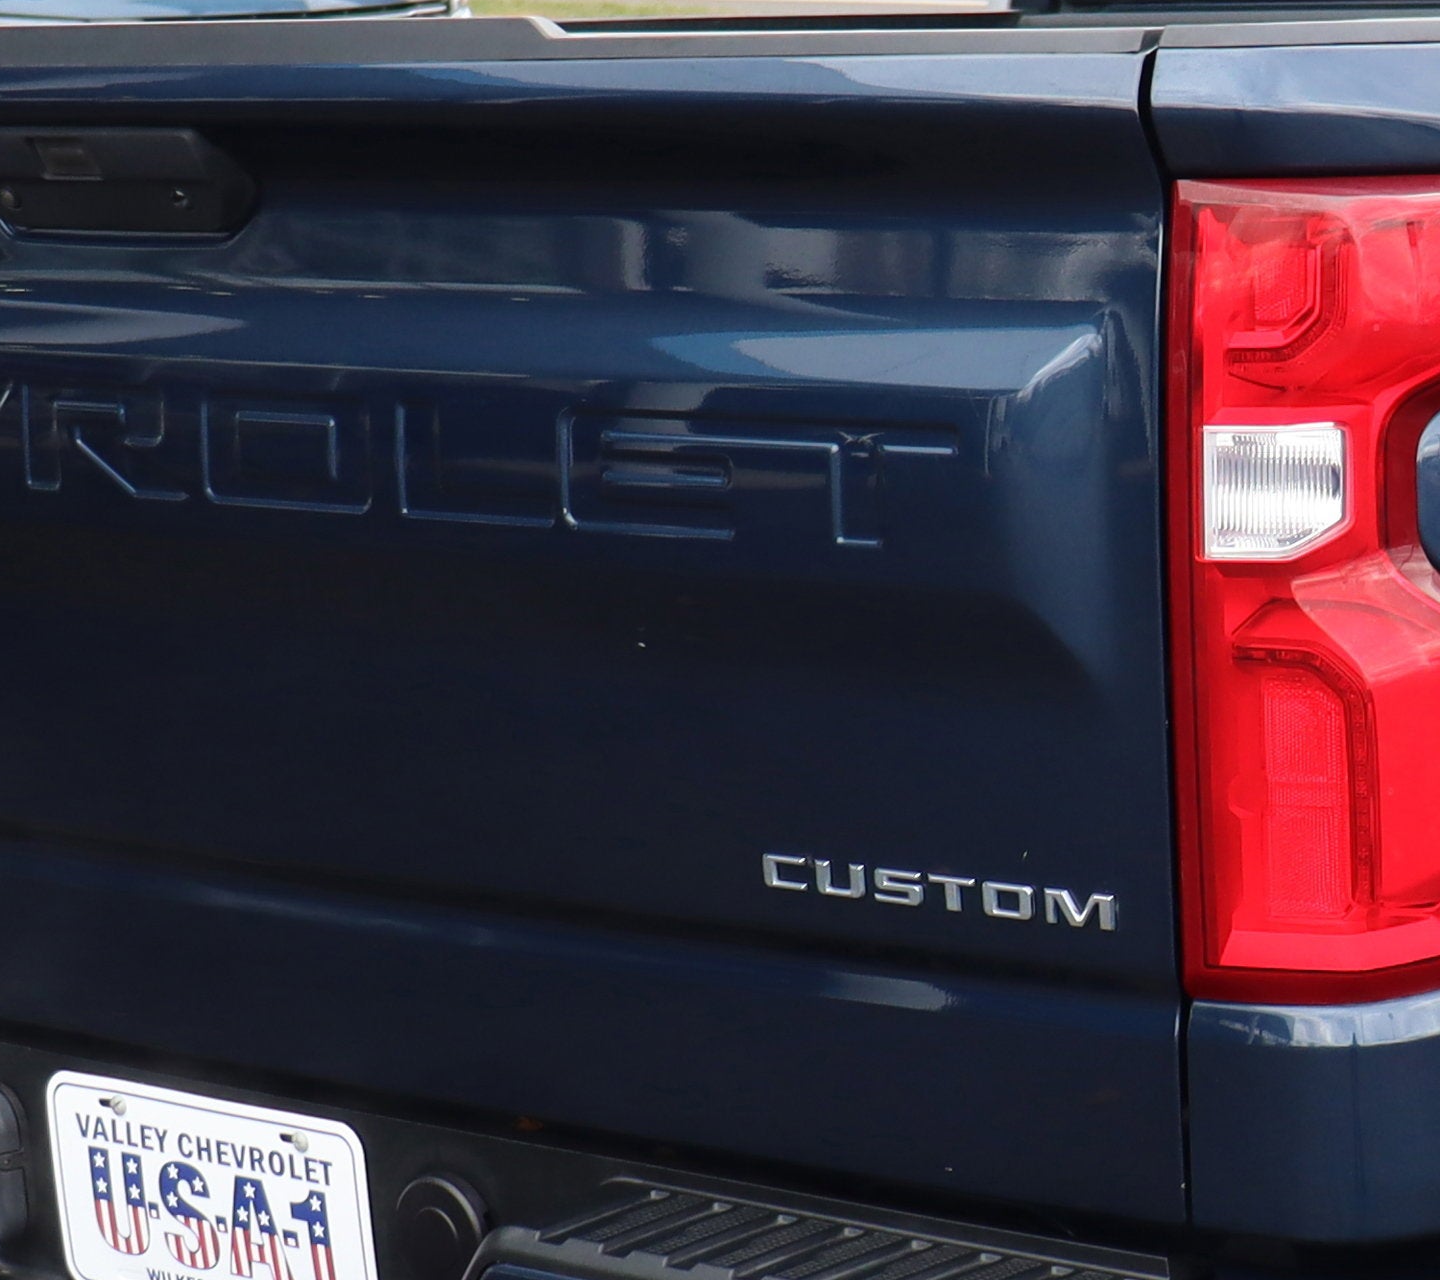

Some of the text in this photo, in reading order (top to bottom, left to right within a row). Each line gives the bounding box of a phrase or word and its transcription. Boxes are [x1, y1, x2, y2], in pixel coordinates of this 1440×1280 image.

[762, 853, 1117, 931] CUSTOM
[74, 1112, 332, 1186] VALLEY CHEVROLET
